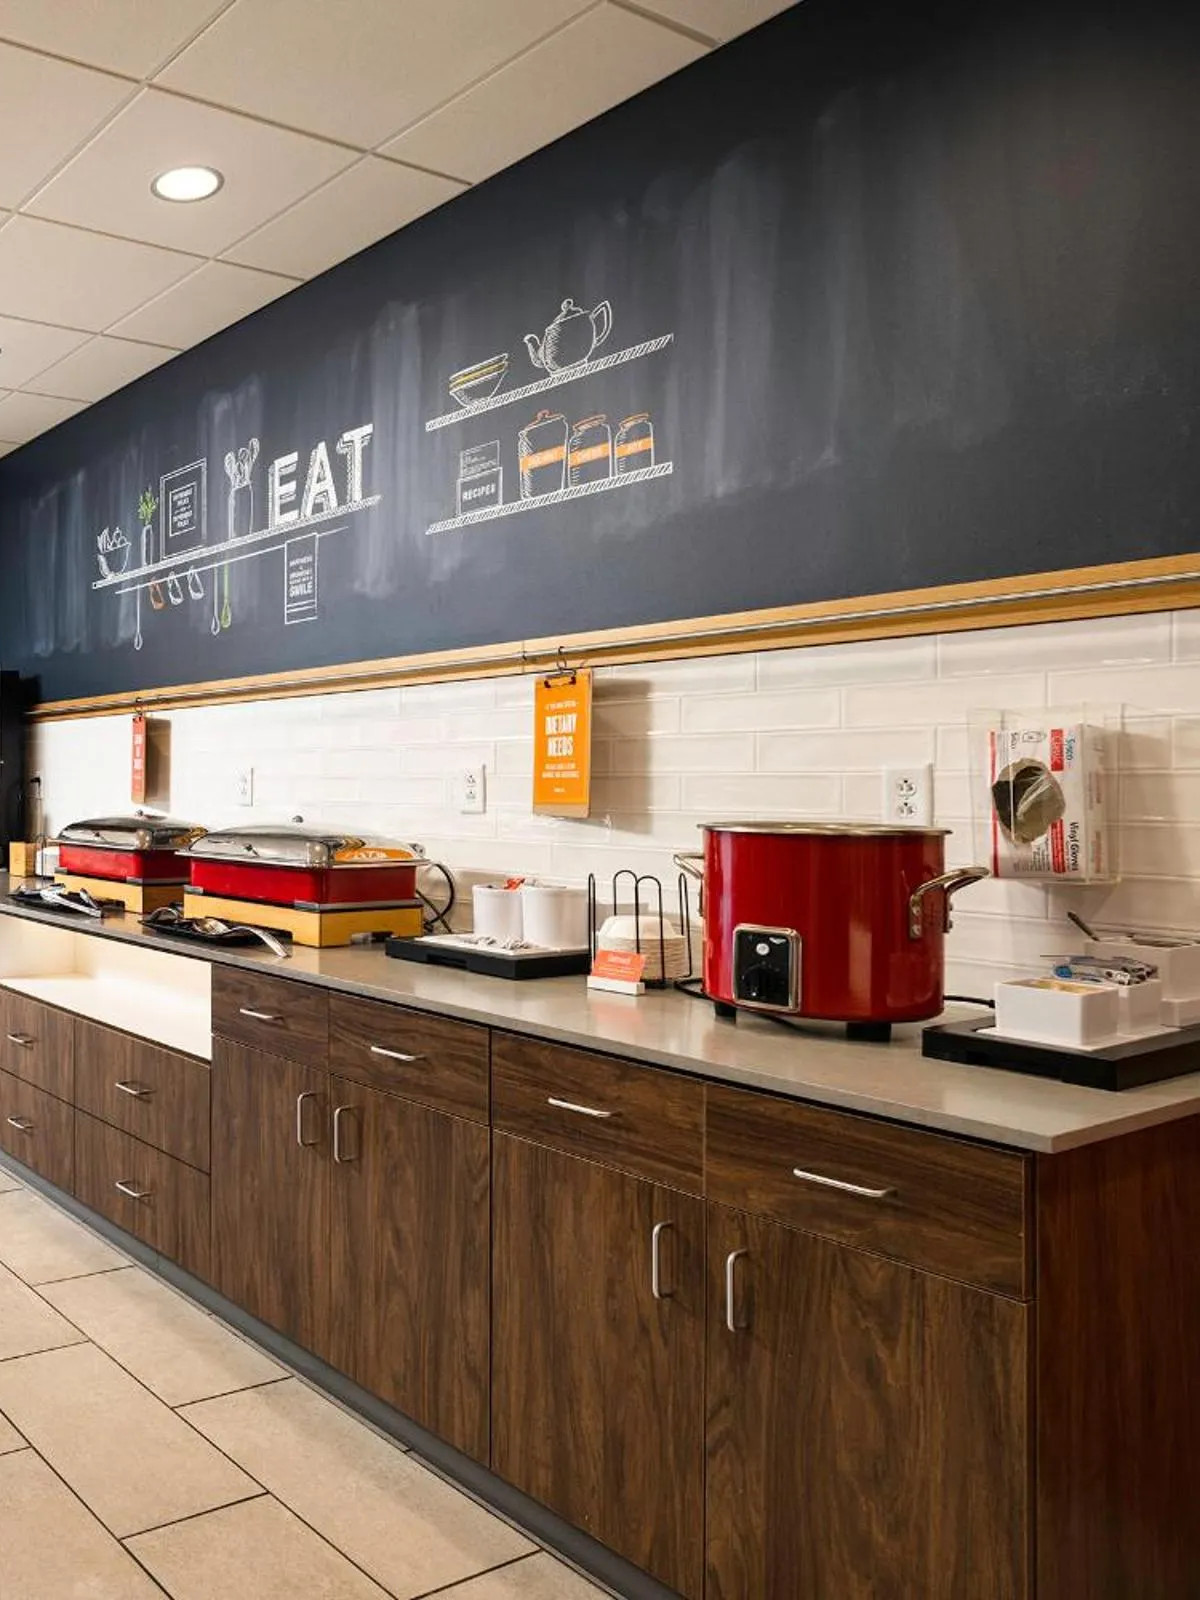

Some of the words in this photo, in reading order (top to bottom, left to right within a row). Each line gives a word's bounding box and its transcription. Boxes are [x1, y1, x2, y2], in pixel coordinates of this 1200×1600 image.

[269, 423, 373, 527] EAT
[462, 482, 496, 502] RECIPES
[545, 713, 577, 736] DIETARY
[547, 735, 574, 757] NEEDS
[1068, 822, 1079, 841] Vinyl
[1069, 842, 1080, 872] Gloves
